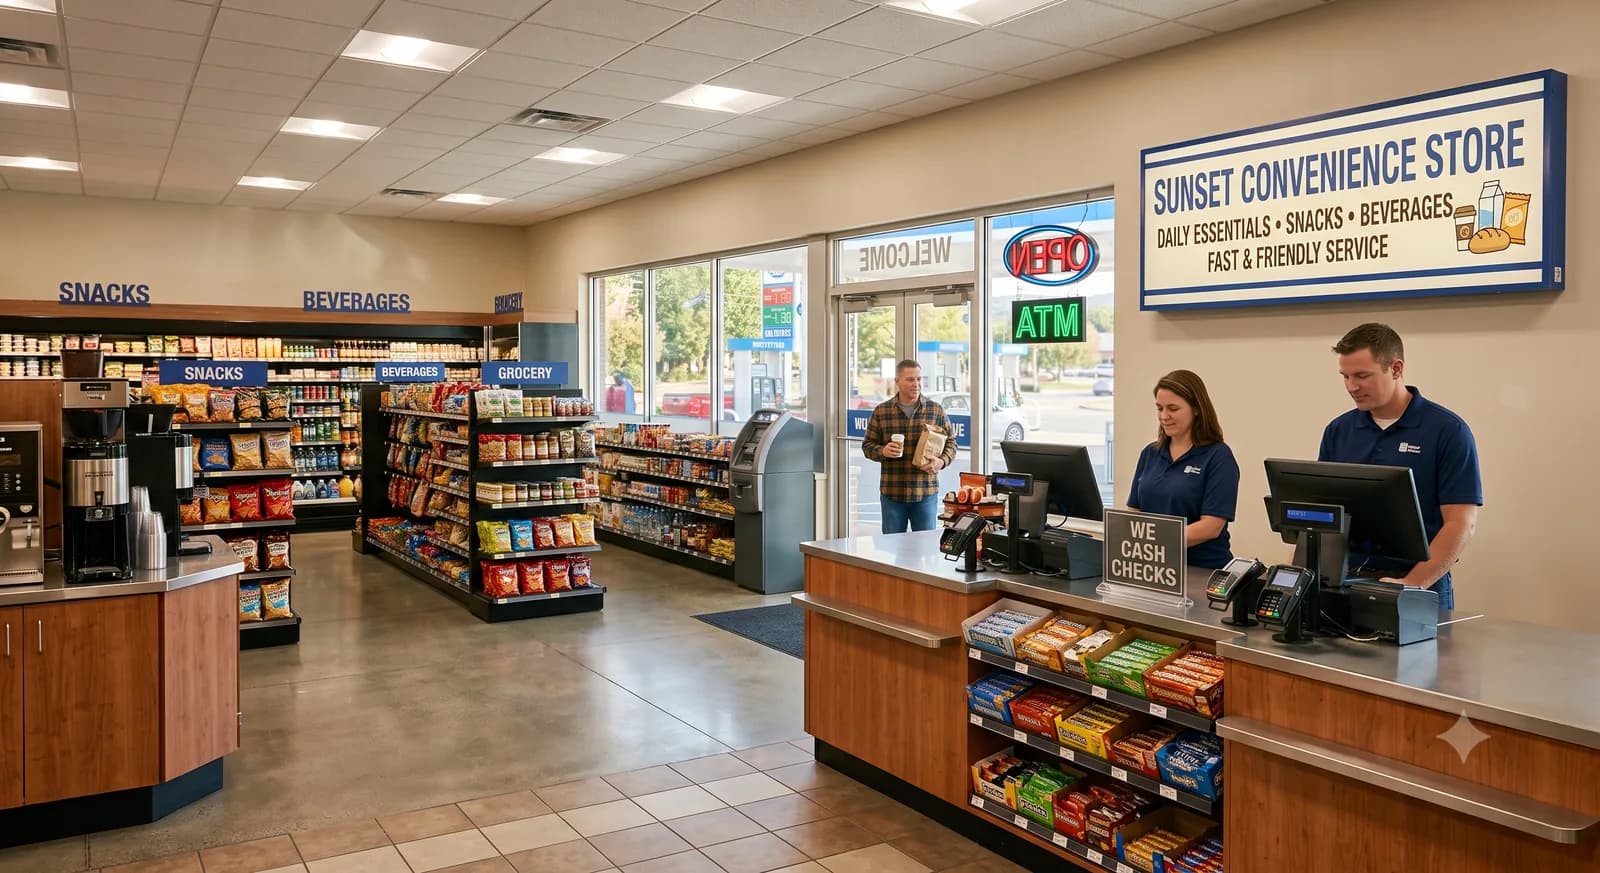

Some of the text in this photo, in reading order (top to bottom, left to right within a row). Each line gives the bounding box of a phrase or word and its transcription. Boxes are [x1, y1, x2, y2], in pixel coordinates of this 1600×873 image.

[1154, 119, 1524, 215] SUNSET CONVENIENCE STORE
[1158, 192, 1453, 248] DAILY ESSENTIALS SNACKS BEVERAGES
[1208, 234, 1389, 272] FAST & FRIENDLY SERVICE
[59, 282, 150, 304] SNACKS
[303, 290, 410, 311] BEVERAGES
[1016, 303, 1079, 338] ATM
[184, 366, 244, 381] SNACKS
[382, 366, 439, 377] BEVERAGES
[498, 366, 553, 379] GROCERY
[1130, 520, 1156, 541] WE
[1121, 540, 1165, 563] CASH
[1111, 558, 1177, 587] CHECKS
